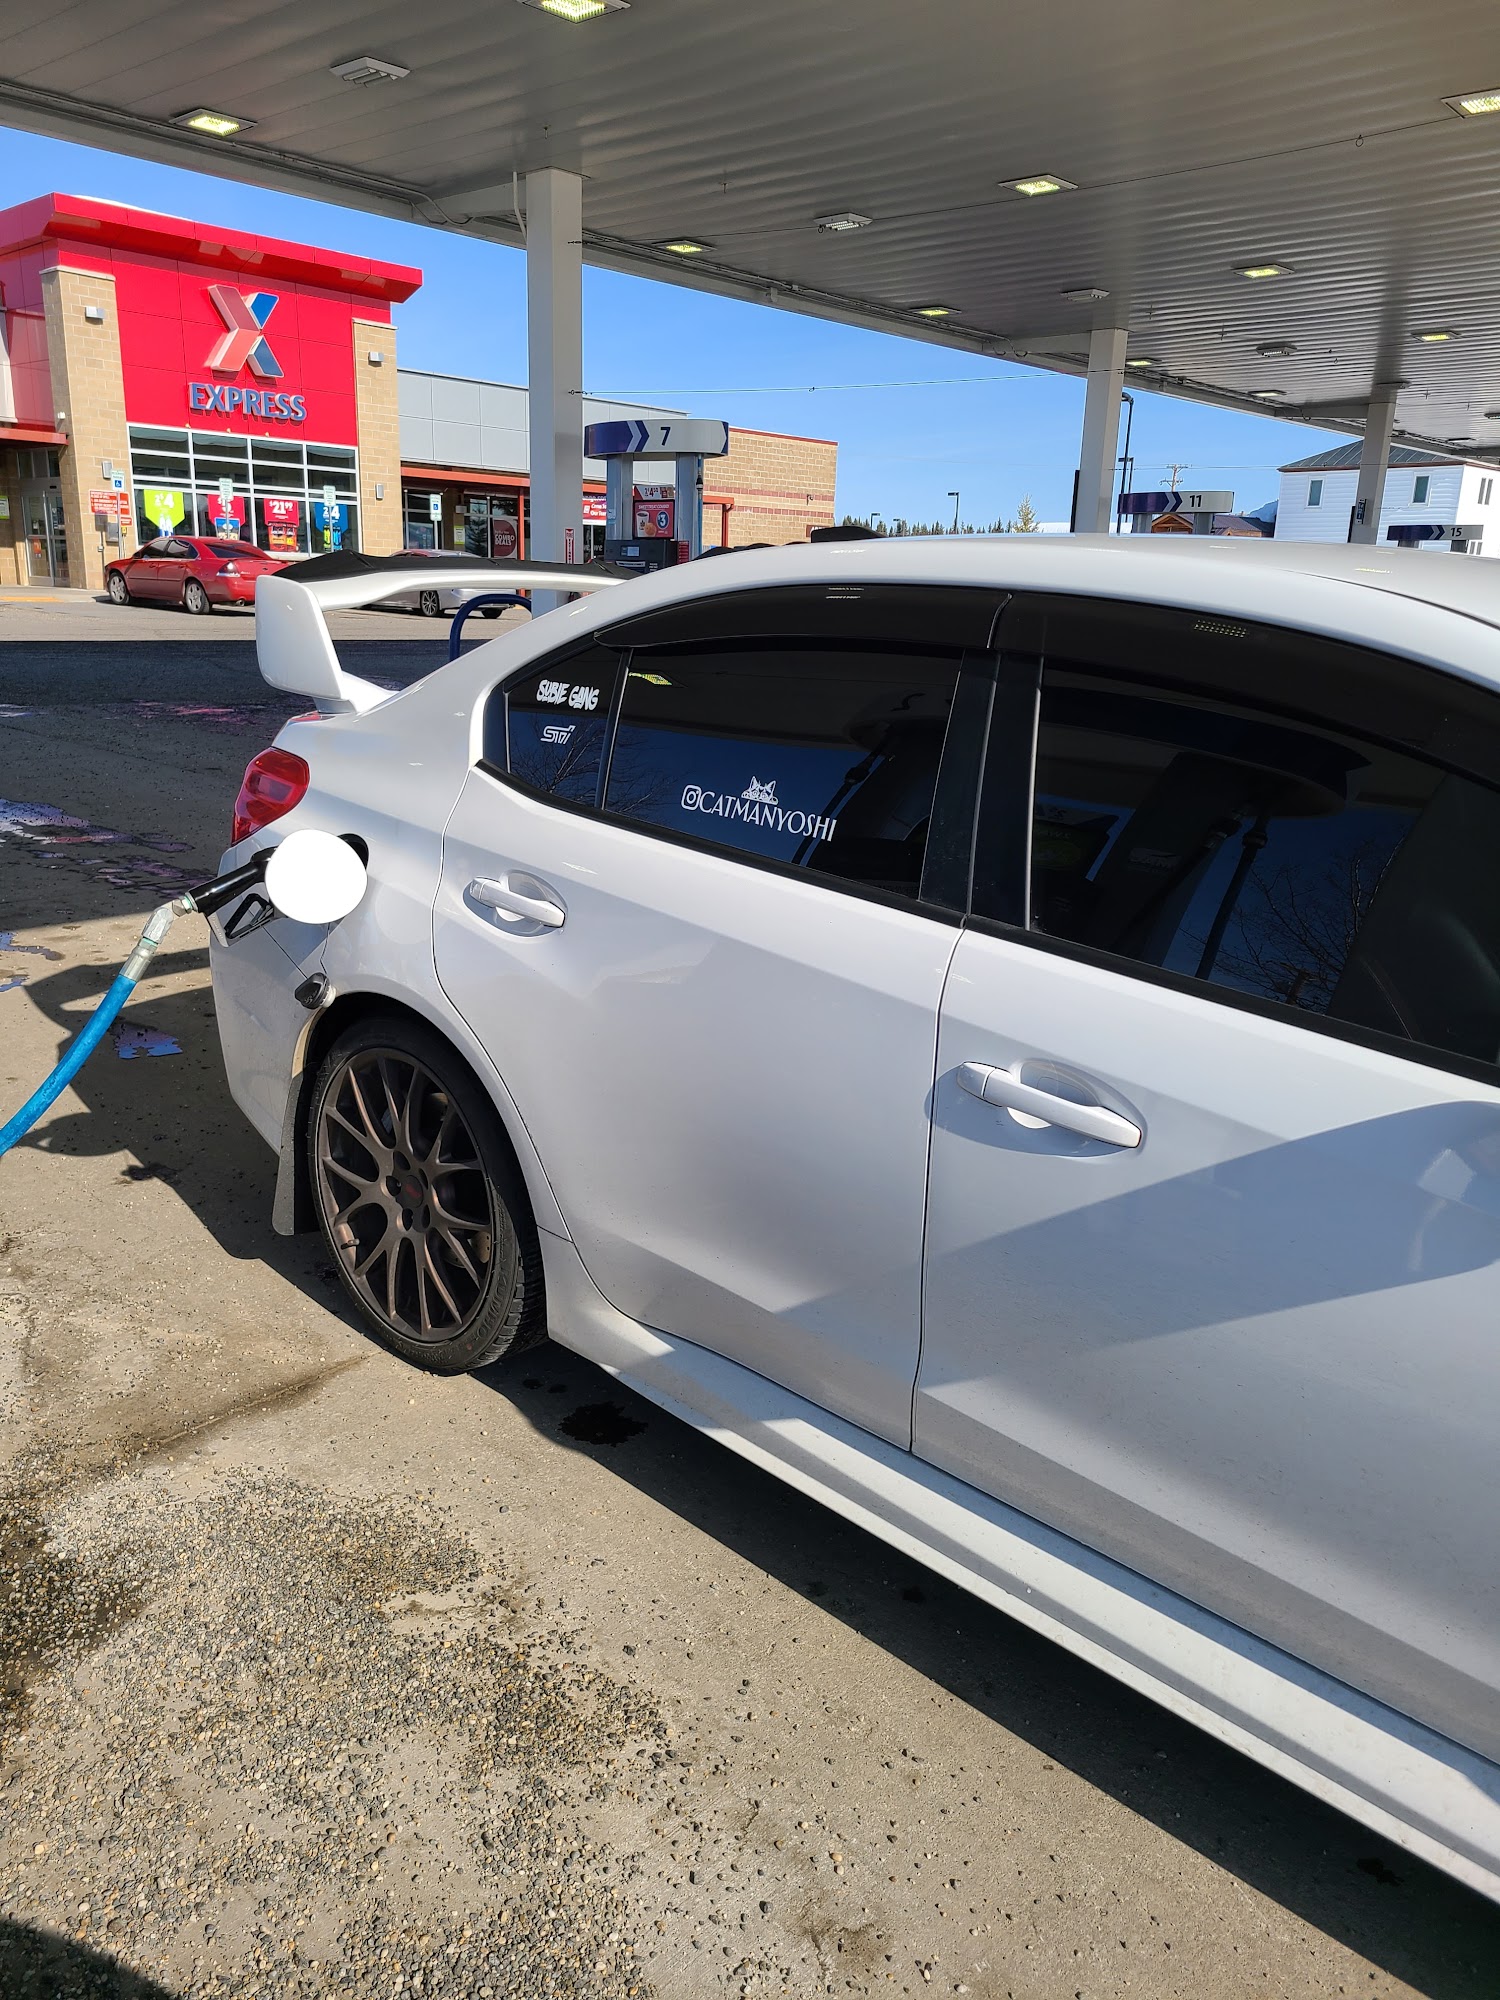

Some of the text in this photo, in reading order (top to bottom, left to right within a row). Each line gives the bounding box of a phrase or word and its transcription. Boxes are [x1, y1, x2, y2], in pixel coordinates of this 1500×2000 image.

[189, 382, 307, 421] EXPRESS
[660, 426, 671, 446] 7
[1190, 494, 1202, 507] 11
[1450, 527, 1462, 537] 15
[536, 679, 600, 711] SUBIE GANG
[699, 790, 837, 842] CATMANYOSHI
